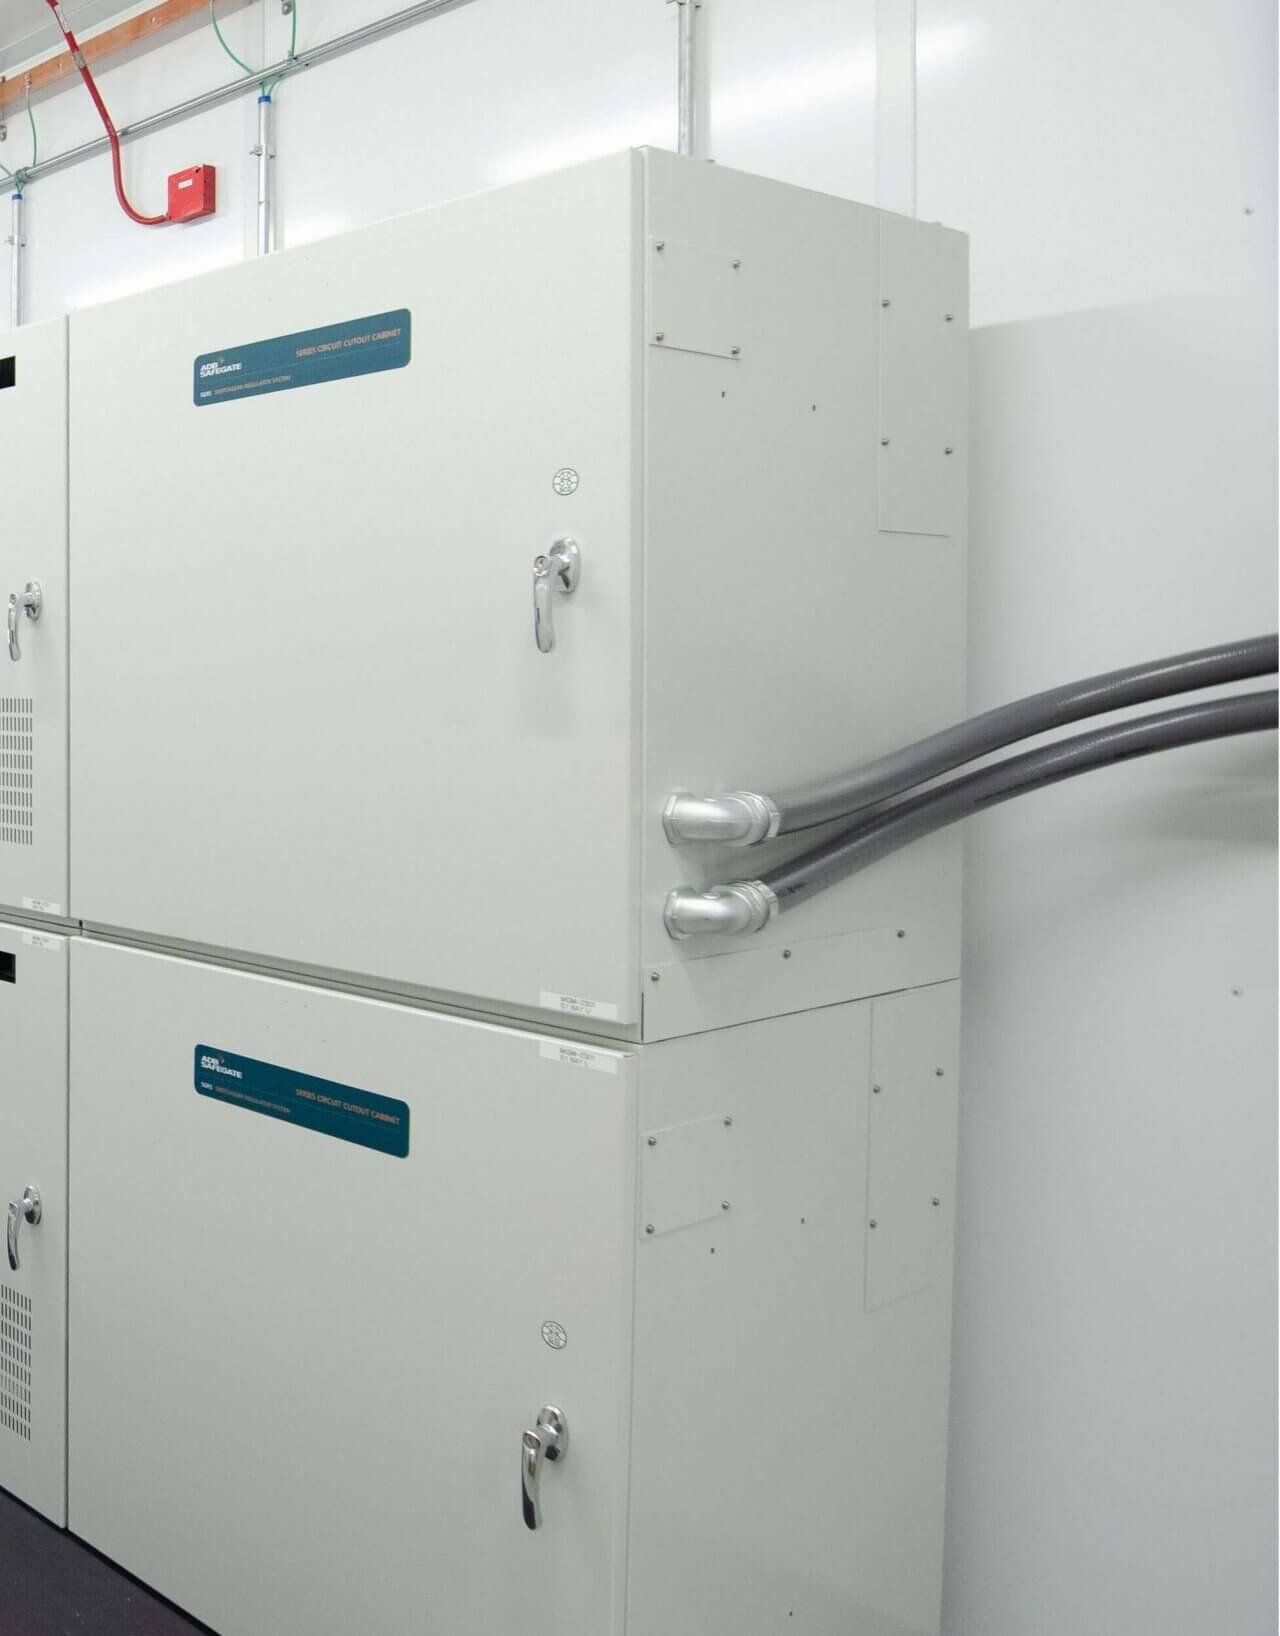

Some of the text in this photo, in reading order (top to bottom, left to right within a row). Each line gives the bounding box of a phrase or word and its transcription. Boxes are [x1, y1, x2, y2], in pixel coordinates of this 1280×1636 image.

[317, 340, 343, 353] CIRCUIT
[343, 335, 371, 348] CUTOUT
[371, 328, 402, 341] CABINET
[200, 362, 243, 378] SAFEGATE
[200, 1061, 243, 1079] SAFEGATE
[342, 1101, 370, 1116] CUTOUT
[370, 1109, 401, 1125] CABINET
